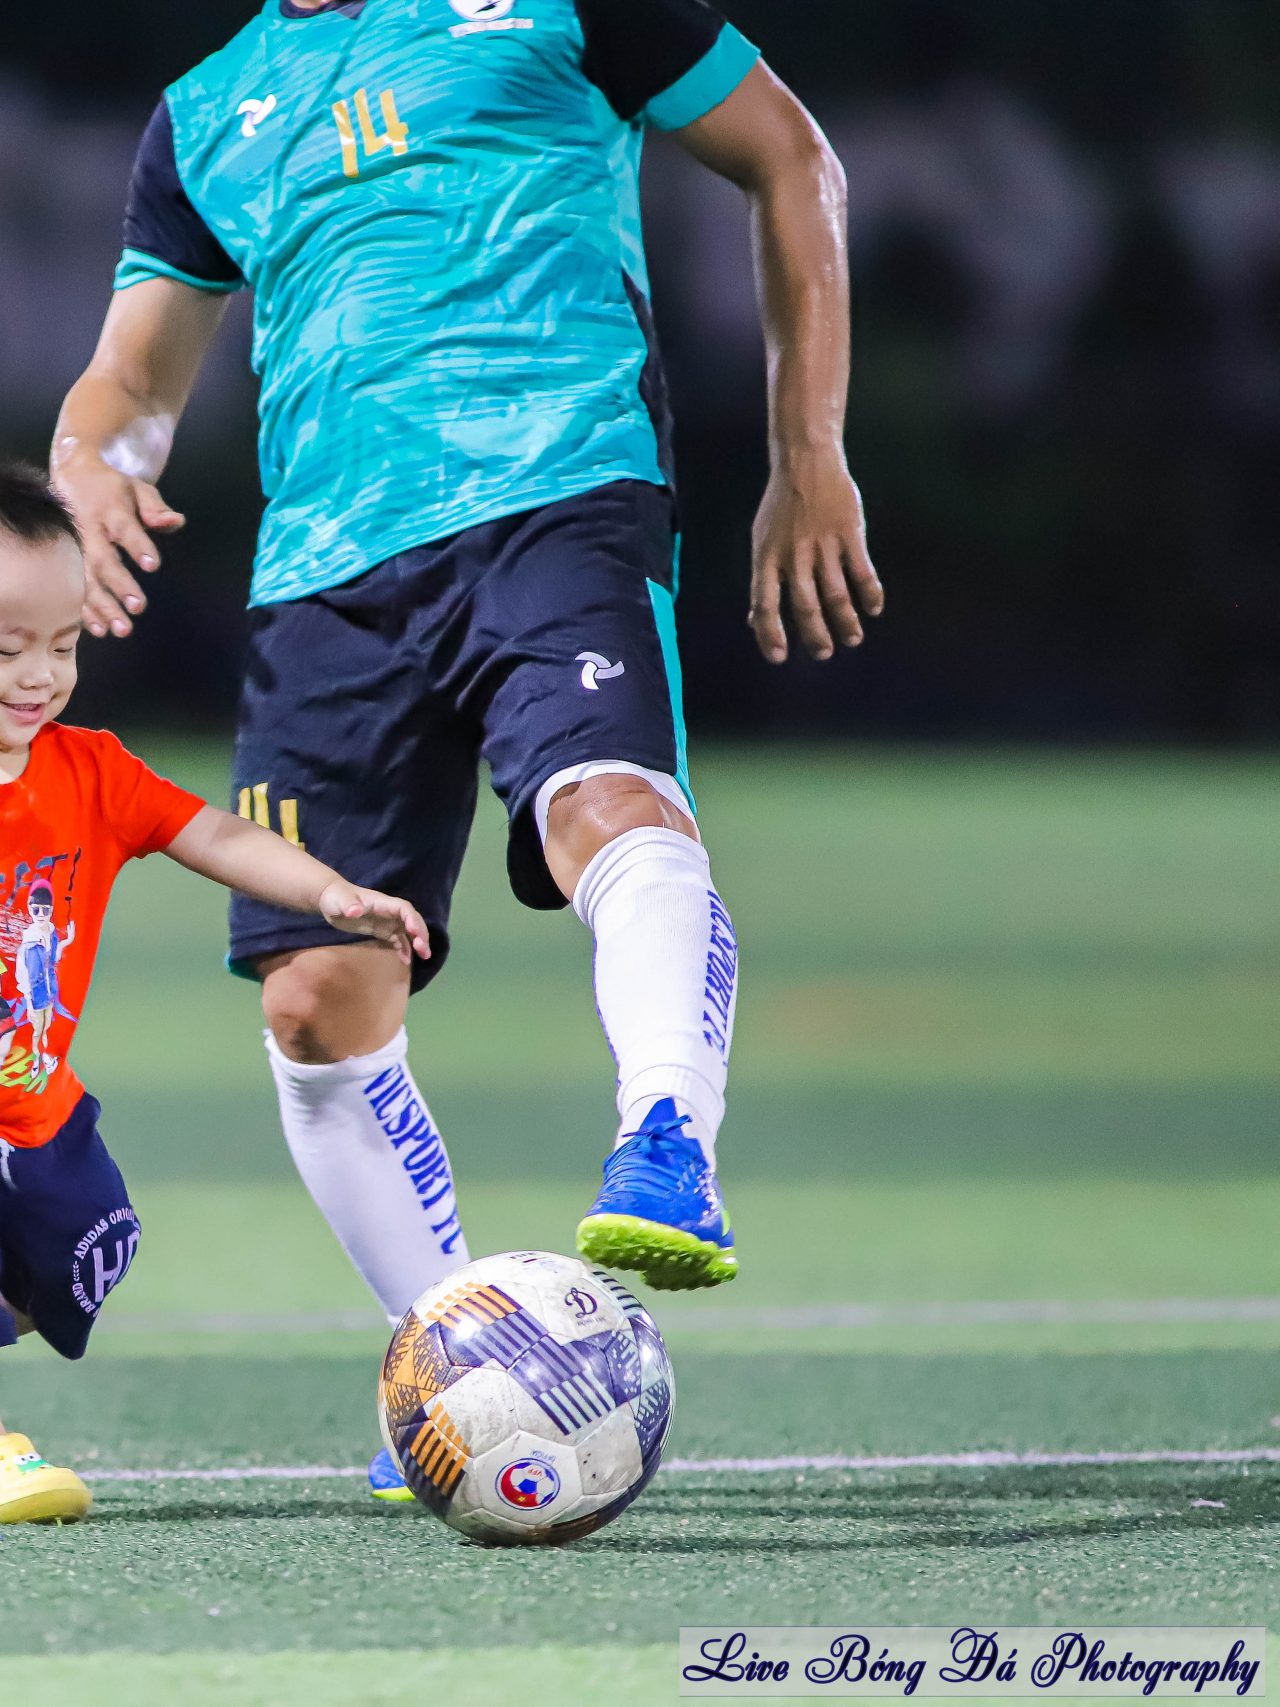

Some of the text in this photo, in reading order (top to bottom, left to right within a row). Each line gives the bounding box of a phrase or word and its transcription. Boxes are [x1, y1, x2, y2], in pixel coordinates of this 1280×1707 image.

[332, 88, 409, 178] 14
[74, 1218, 109, 1260] ADIDAS
[72, 1282, 96, 1314] BRAND
